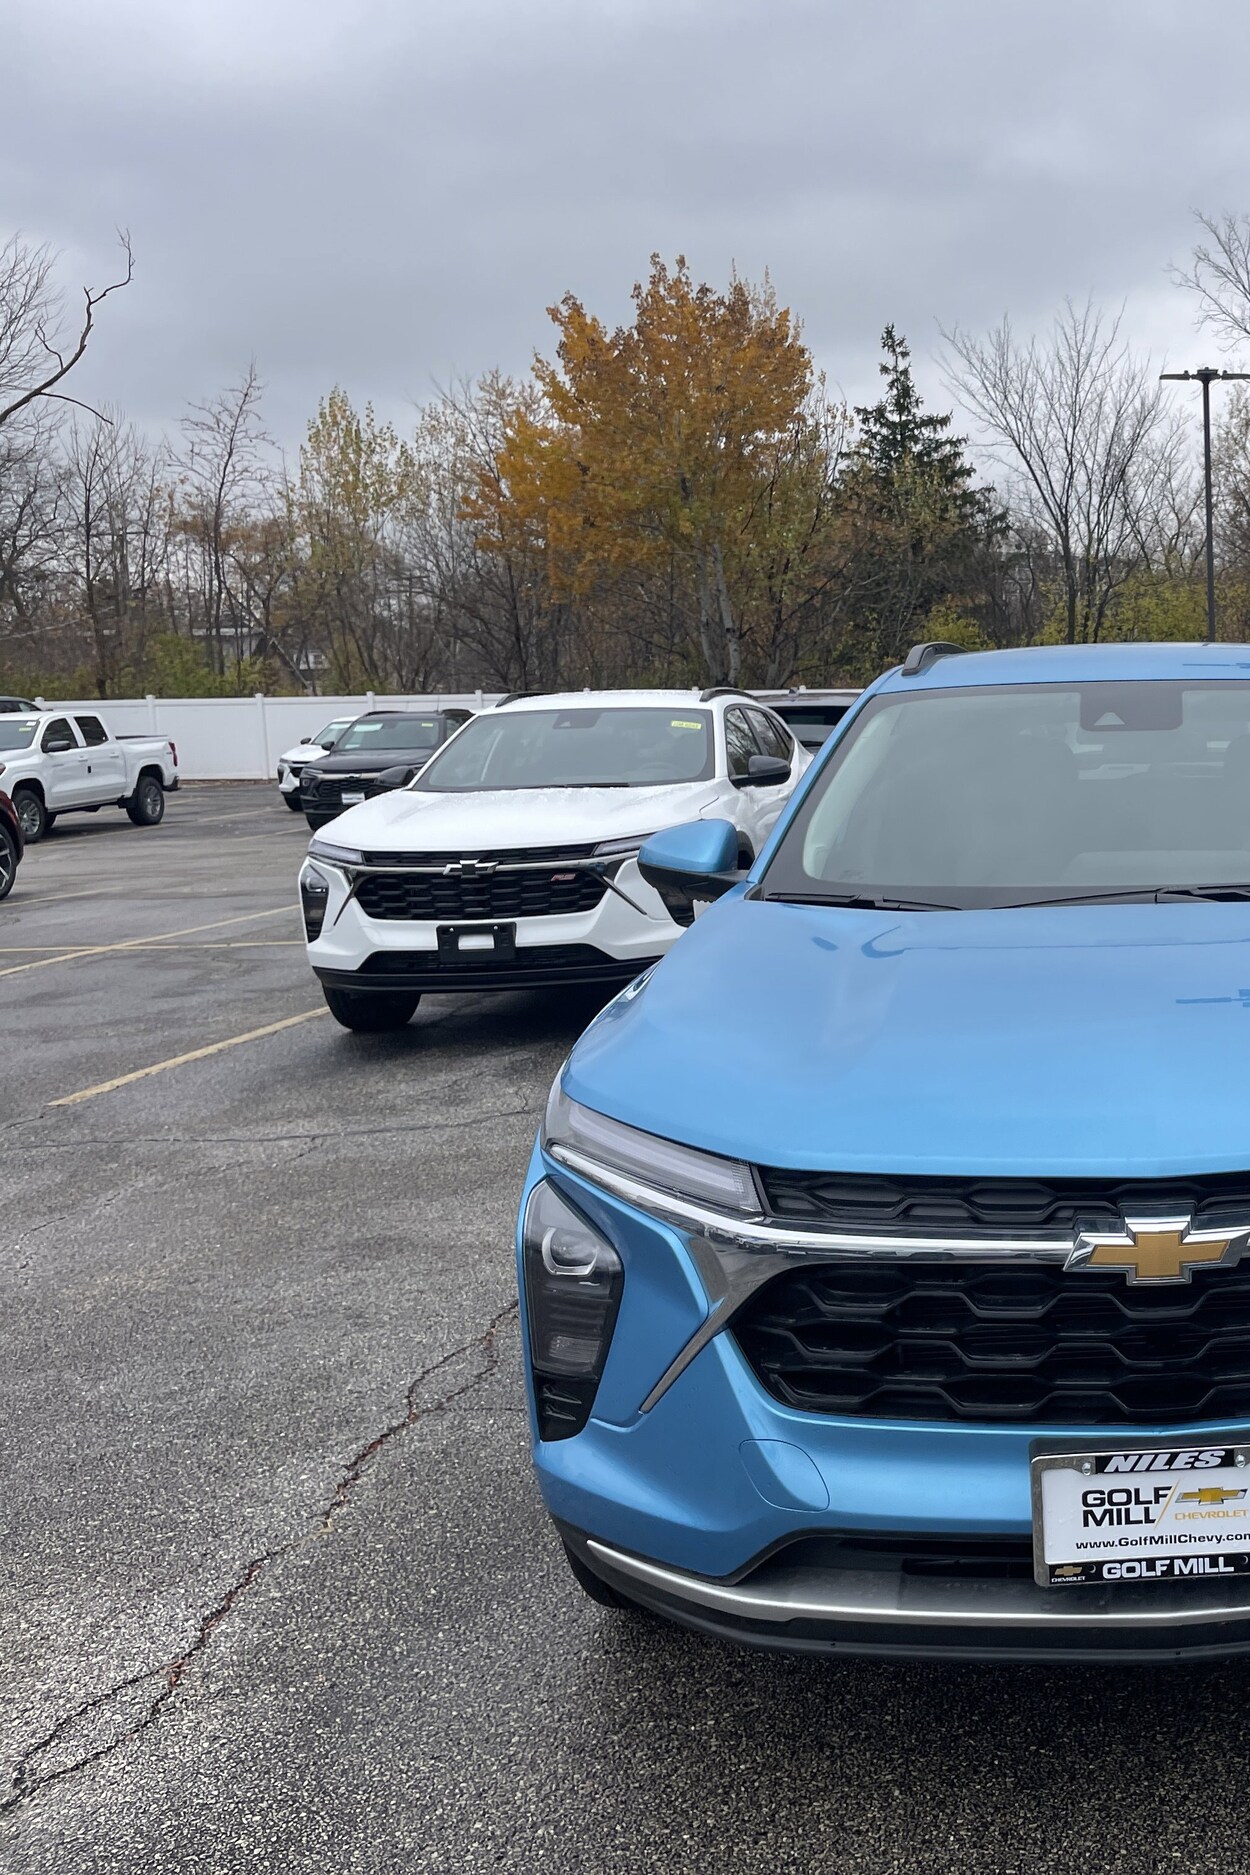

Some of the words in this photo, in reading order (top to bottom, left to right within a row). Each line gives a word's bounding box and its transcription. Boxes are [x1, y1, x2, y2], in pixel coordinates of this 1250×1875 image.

[1104, 1450, 1226, 1473] NILES
[1082, 1486, 1172, 1508] GOLF
[1083, 1507, 1157, 1527] MILL
[1174, 1509, 1249, 1521] CHEVROLET
[1102, 1559, 1171, 1579] GOLF
[1174, 1557, 1235, 1575] MILL
